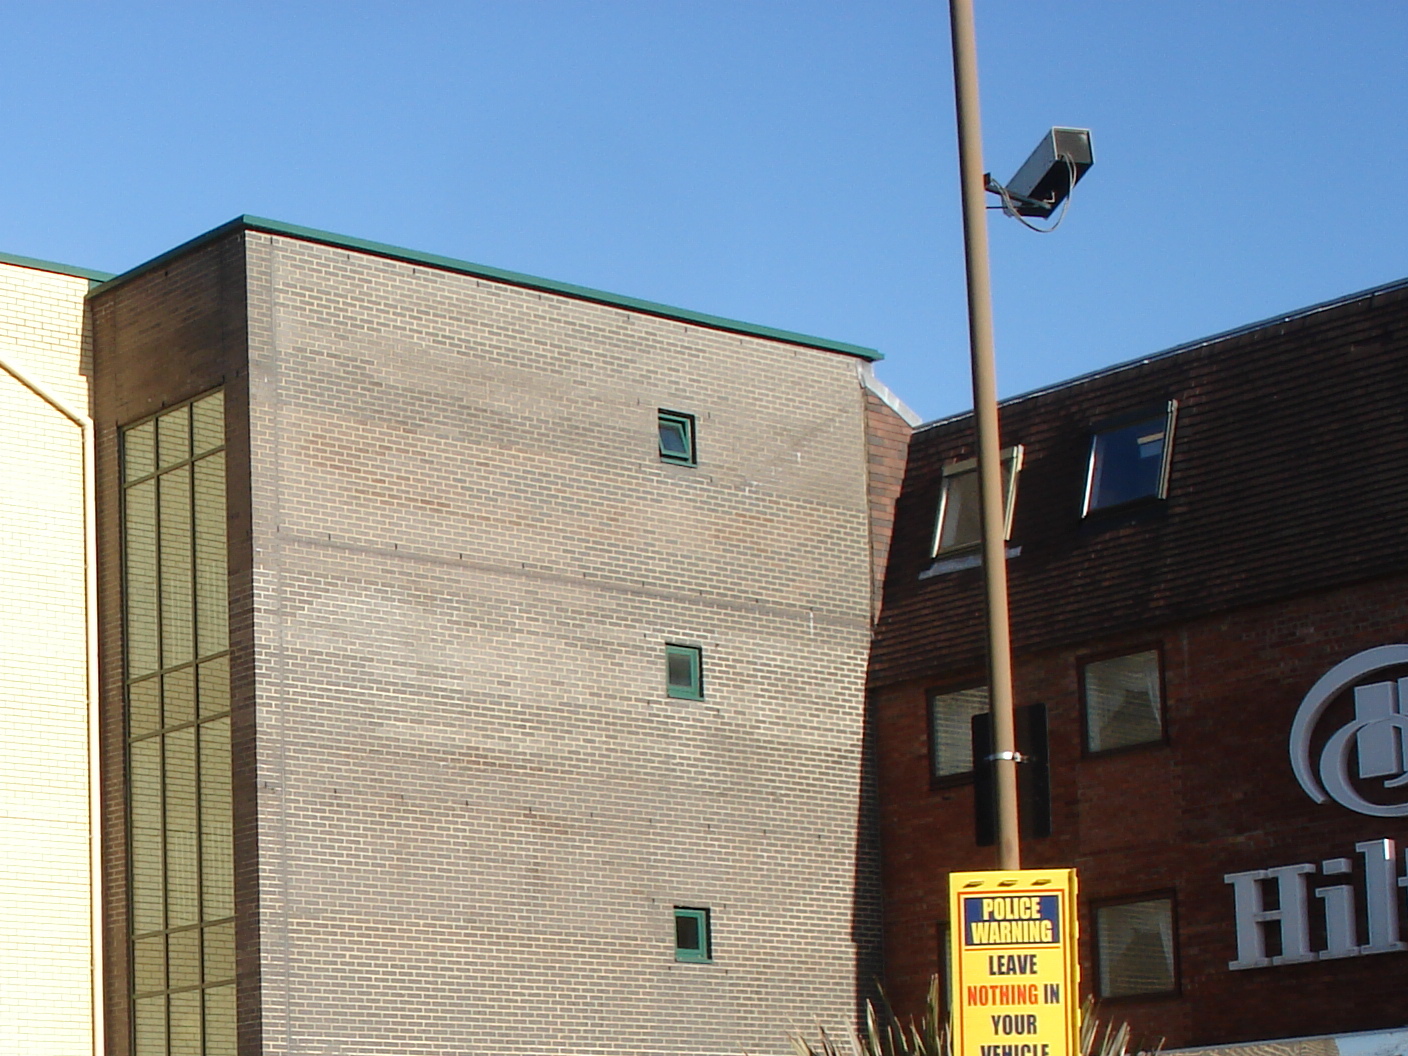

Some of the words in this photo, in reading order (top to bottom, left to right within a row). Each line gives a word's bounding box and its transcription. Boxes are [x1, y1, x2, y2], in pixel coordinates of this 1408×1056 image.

[983, 897, 1041, 920] POLICE
[1224, 838, 1408, 971] Hil
[971, 920, 1053, 944] WARNING
[988, 954, 1038, 976] LEAVE
[967, 984, 1039, 1007] NOTHING
[1044, 983, 1060, 1004] IN
[991, 1014, 1037, 1036] YOUR
